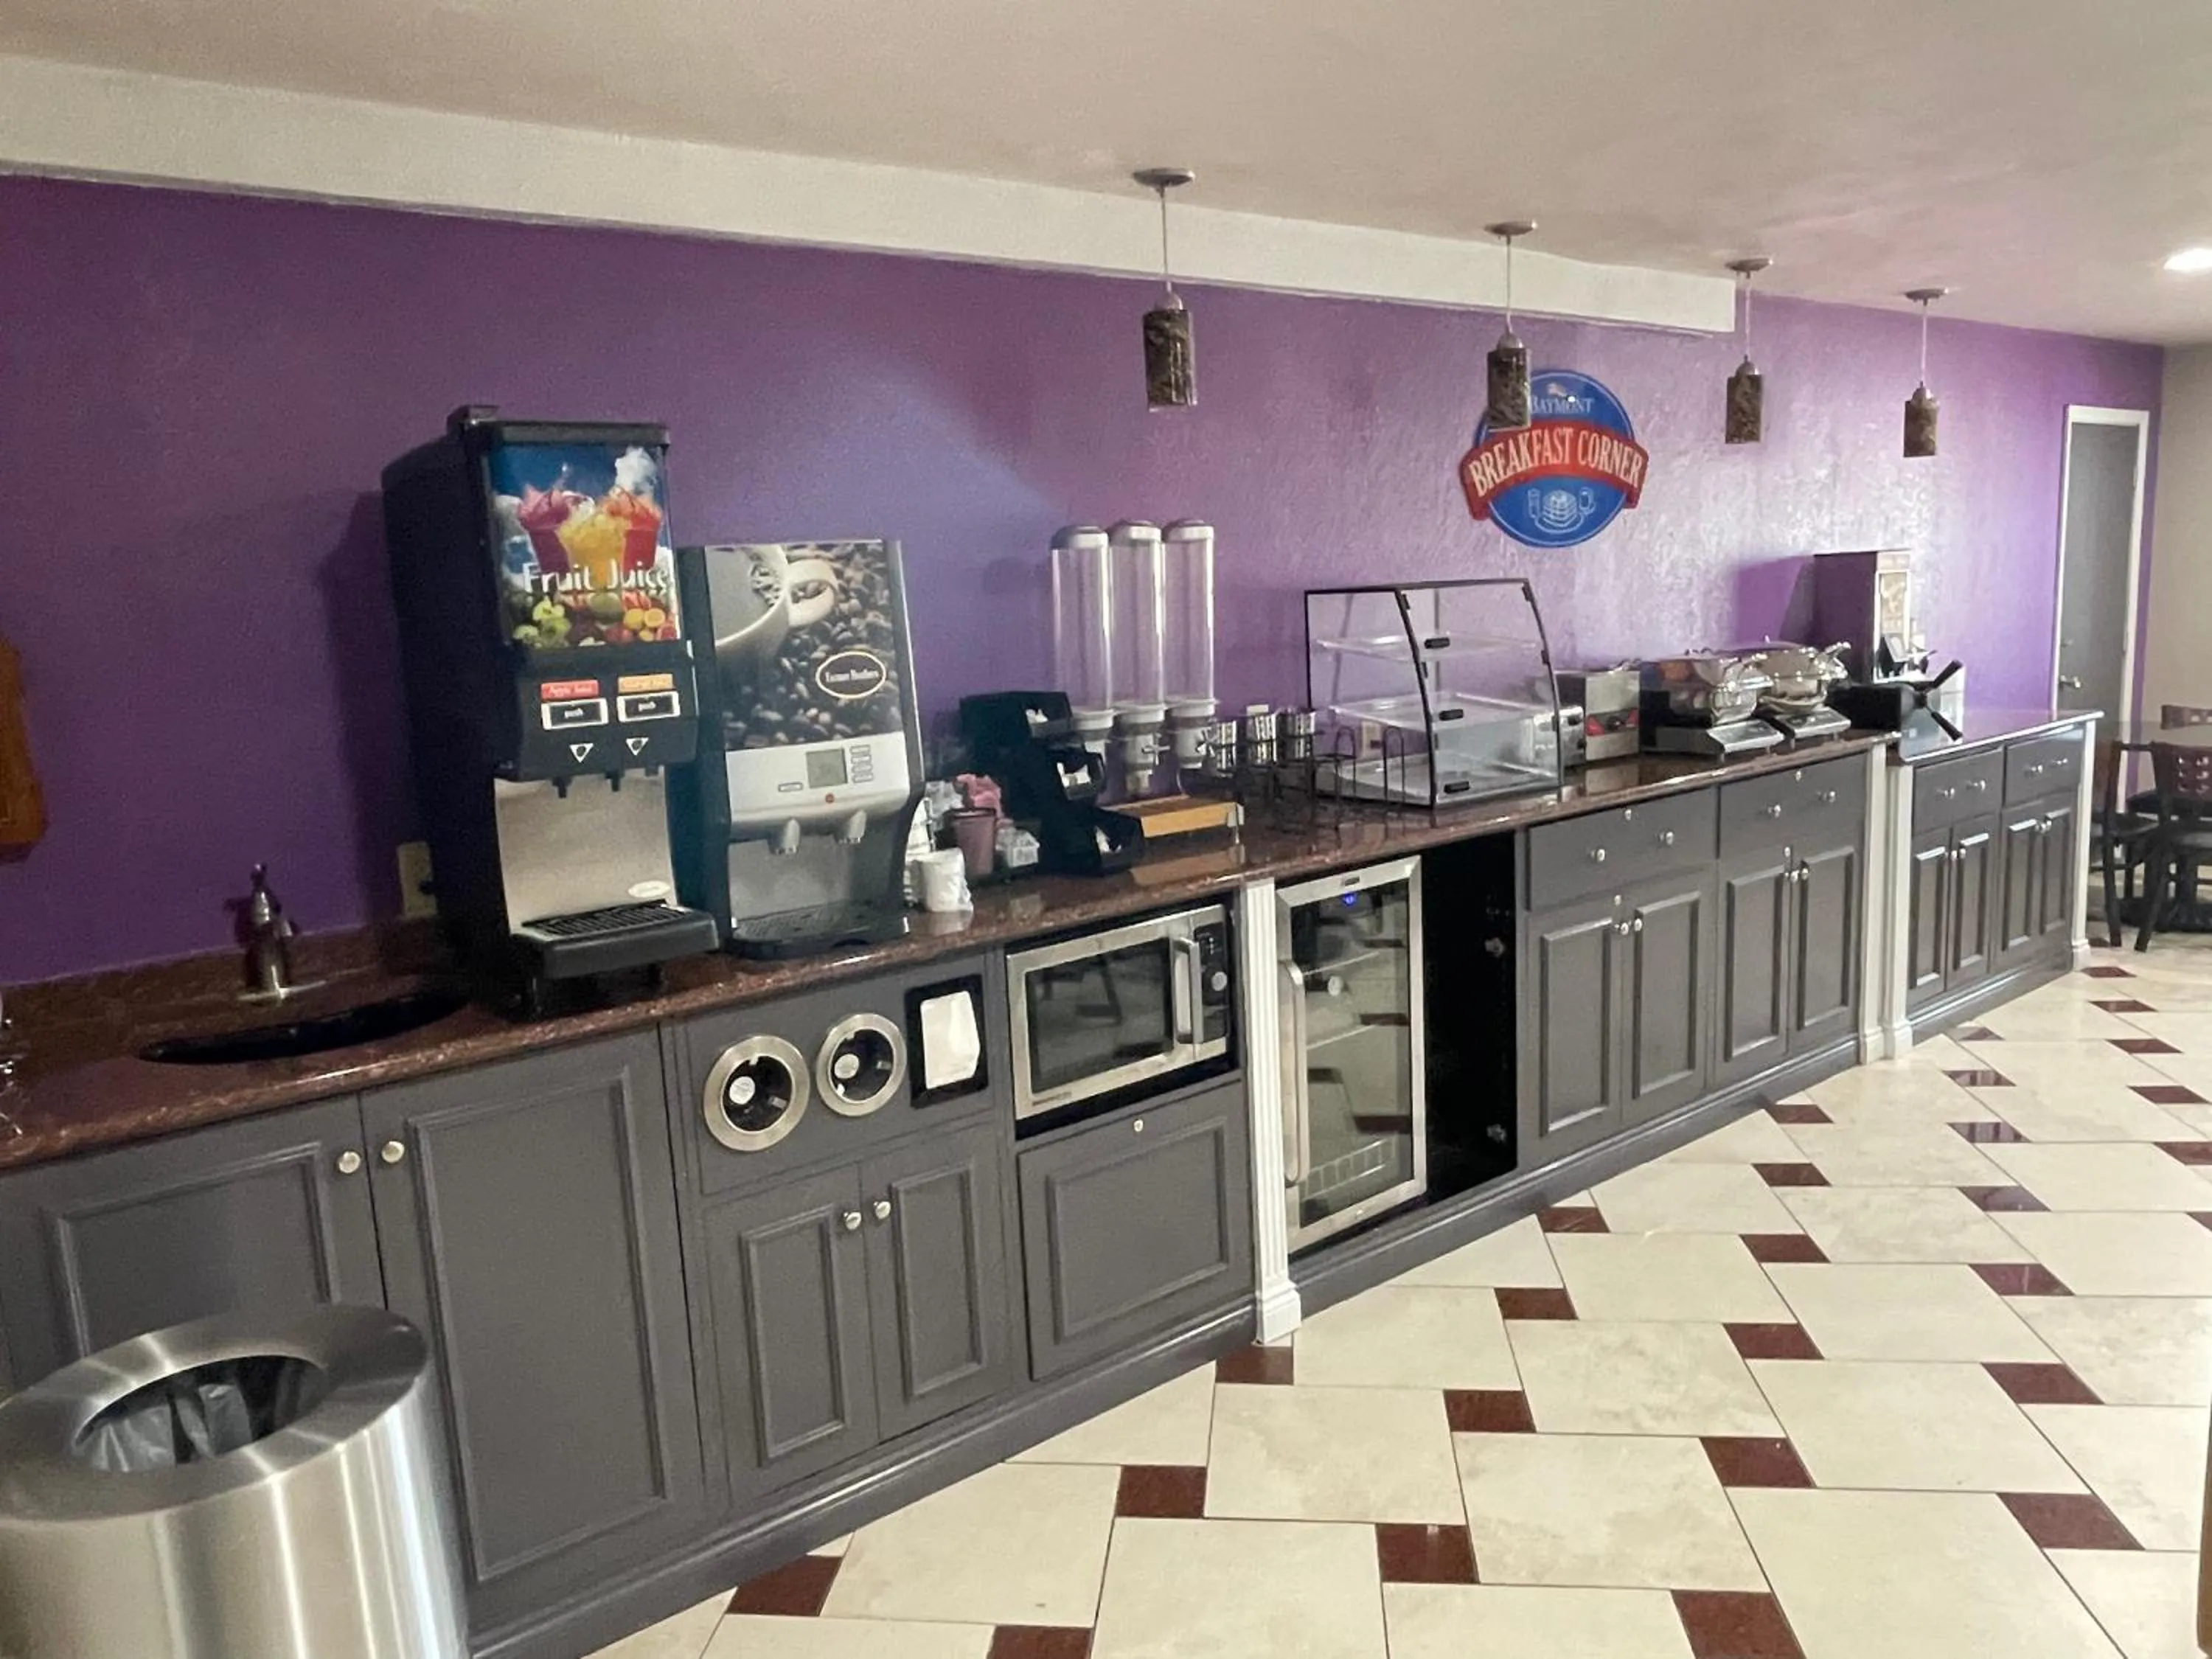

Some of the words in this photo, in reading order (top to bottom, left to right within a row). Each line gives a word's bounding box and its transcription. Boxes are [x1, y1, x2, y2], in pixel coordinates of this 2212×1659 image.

[1469, 427, 1574, 498] BREAKFAST
[1577, 430, 1644, 489] CORNER
[523, 563, 594, 593] Fruit
[607, 558, 668, 588] Juice
